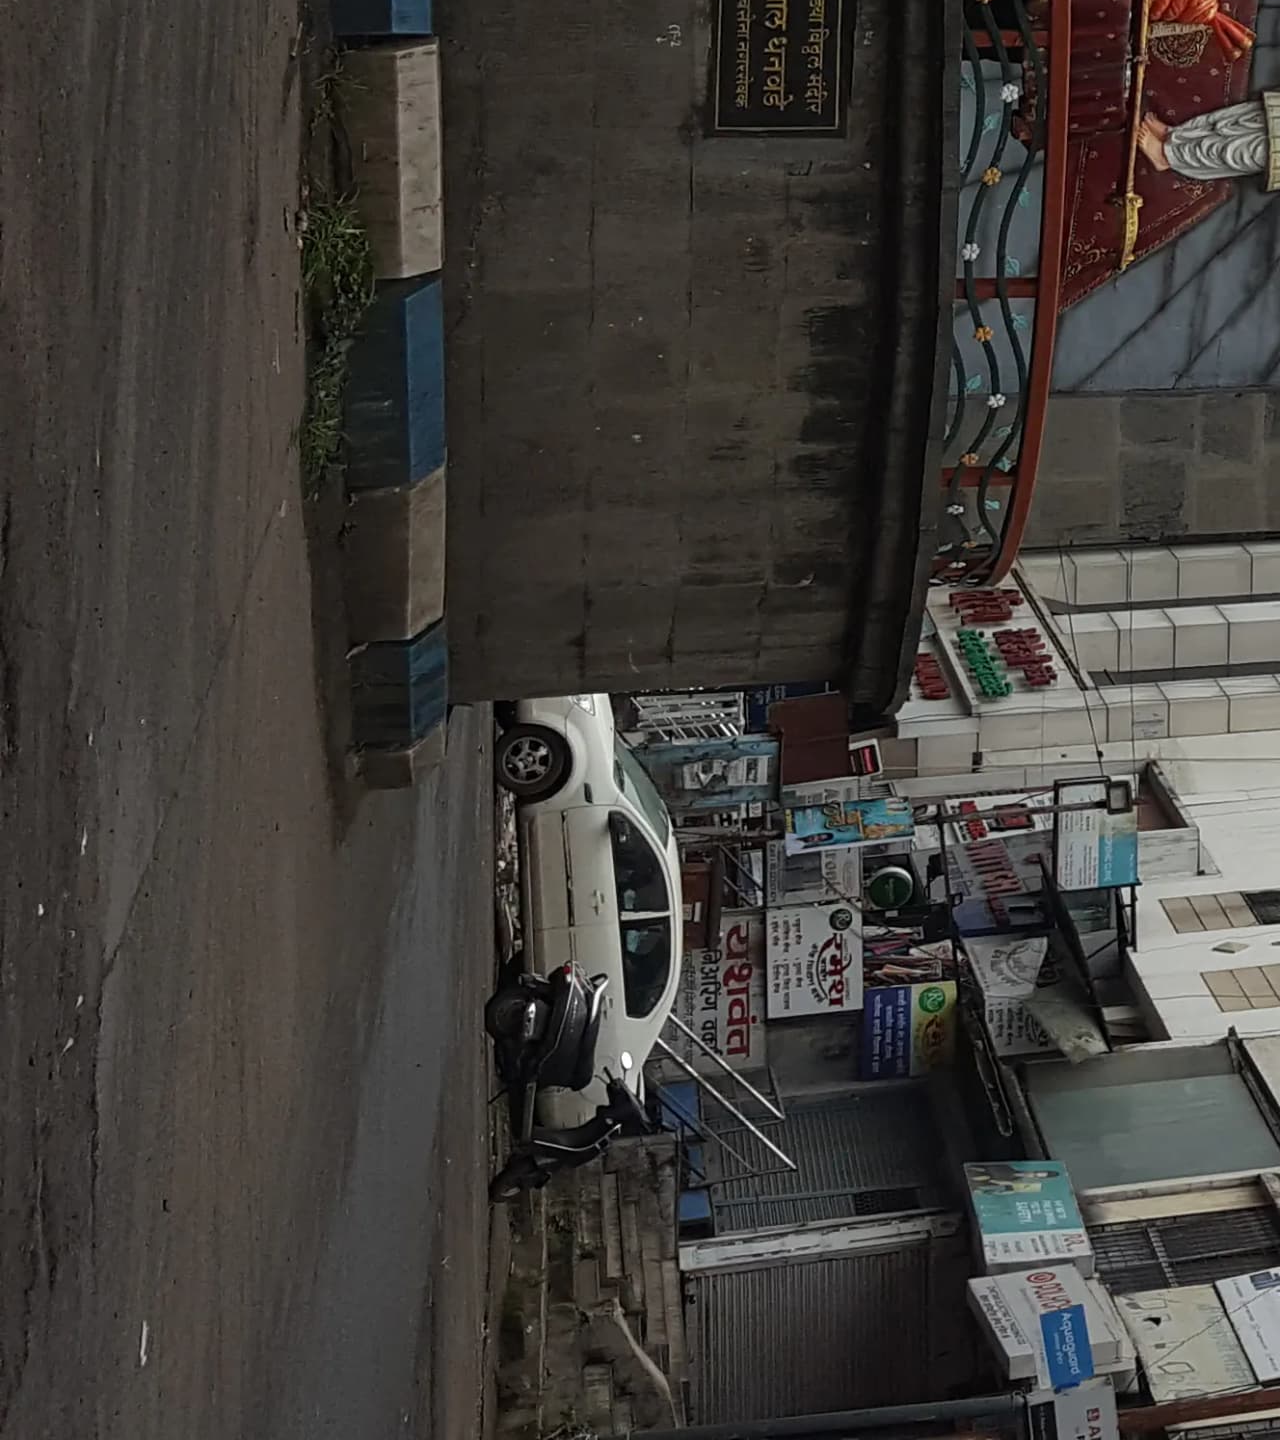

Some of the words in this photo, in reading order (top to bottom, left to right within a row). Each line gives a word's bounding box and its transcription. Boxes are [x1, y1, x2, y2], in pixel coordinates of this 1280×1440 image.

[734, 40, 754, 110] नगरसेवक
[763, 36, 793, 111] धनवडे
[805, 72, 828, 115] मंदीर
[700, 948, 722, 1011] निअरिंग
[723, 922, 757, 1058] यशवंत
[821, 933, 852, 1007] रमेश
[1058, 1312, 1081, 1376] Aquaguard
